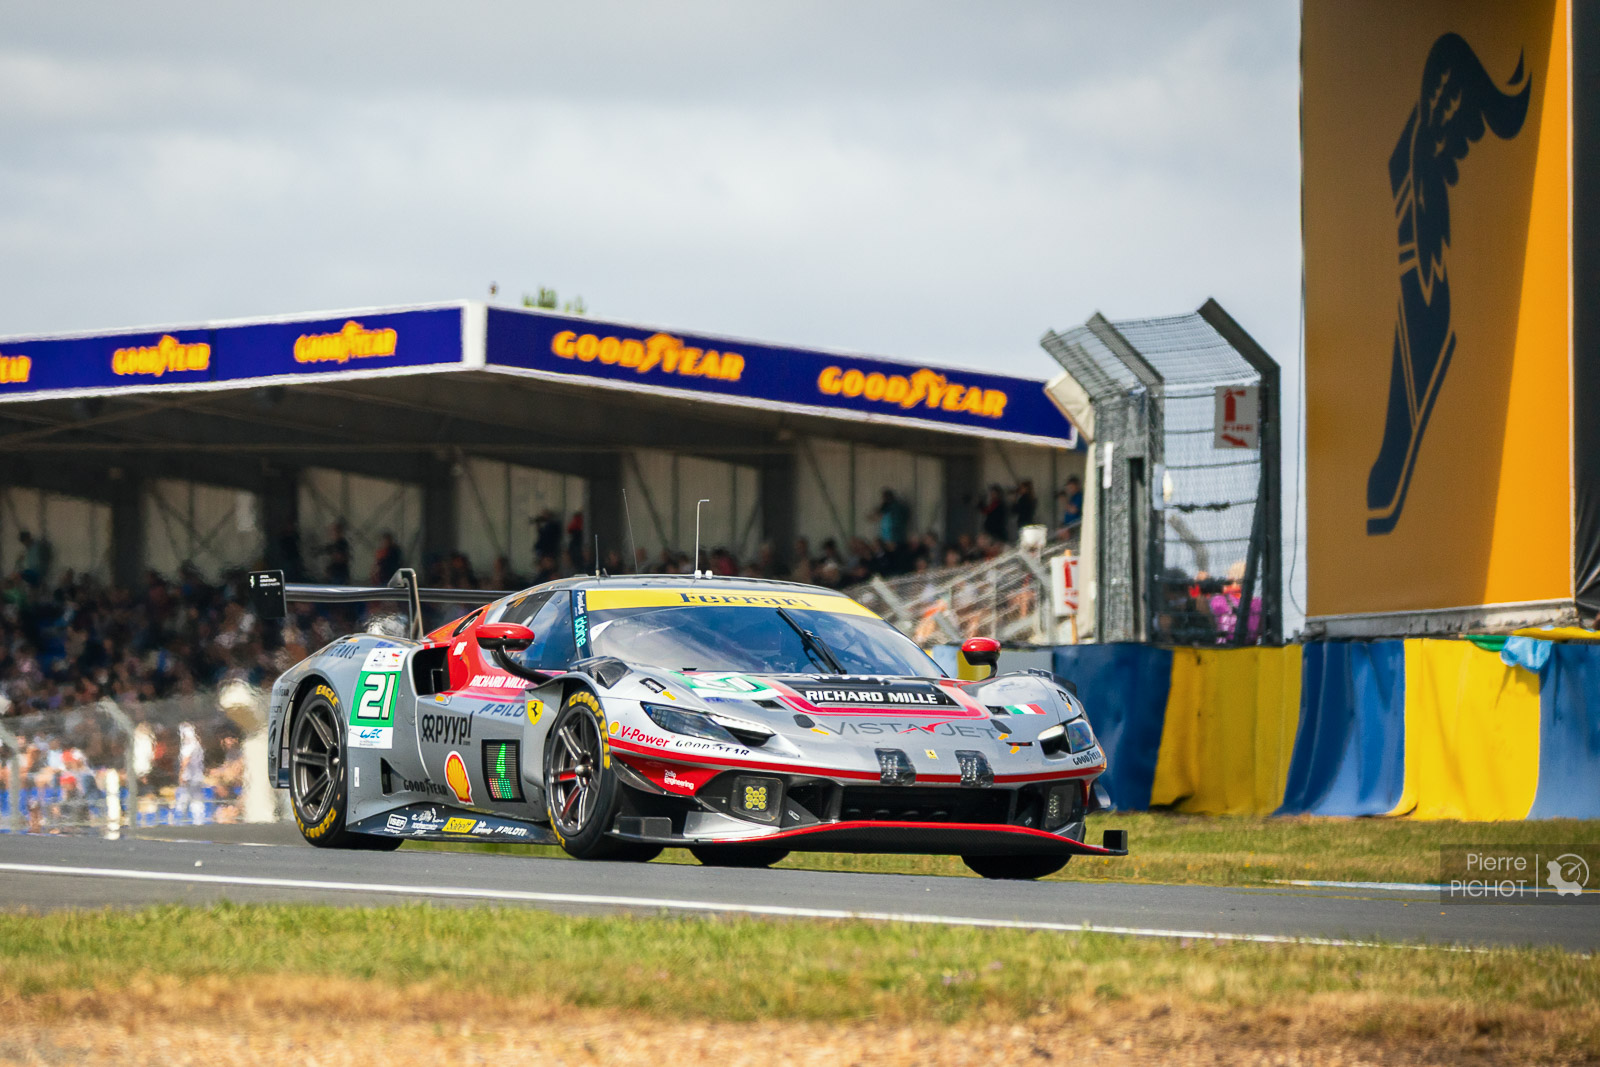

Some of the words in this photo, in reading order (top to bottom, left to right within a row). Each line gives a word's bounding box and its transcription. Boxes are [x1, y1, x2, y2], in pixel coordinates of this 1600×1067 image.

[294, 320, 397, 363] GOODYEAR
[111, 335, 210, 377] GOODYEAR
[552, 332, 745, 381] GOODYEAR
[818, 366, 1007, 418] GOODYEAR
[679, 593, 812, 607] Ferrari
[469, 675, 505, 688] RICHARD
[316, 684, 340, 707] EAGLE
[357, 673, 396, 720] 21
[804, 690, 884, 702] RICHARD
[888, 692, 938, 704] MILLE
[621, 725, 670, 747] V-Power
[404, 779, 448, 796] GOODYEAR
[501, 826, 527, 836] PILOTI
